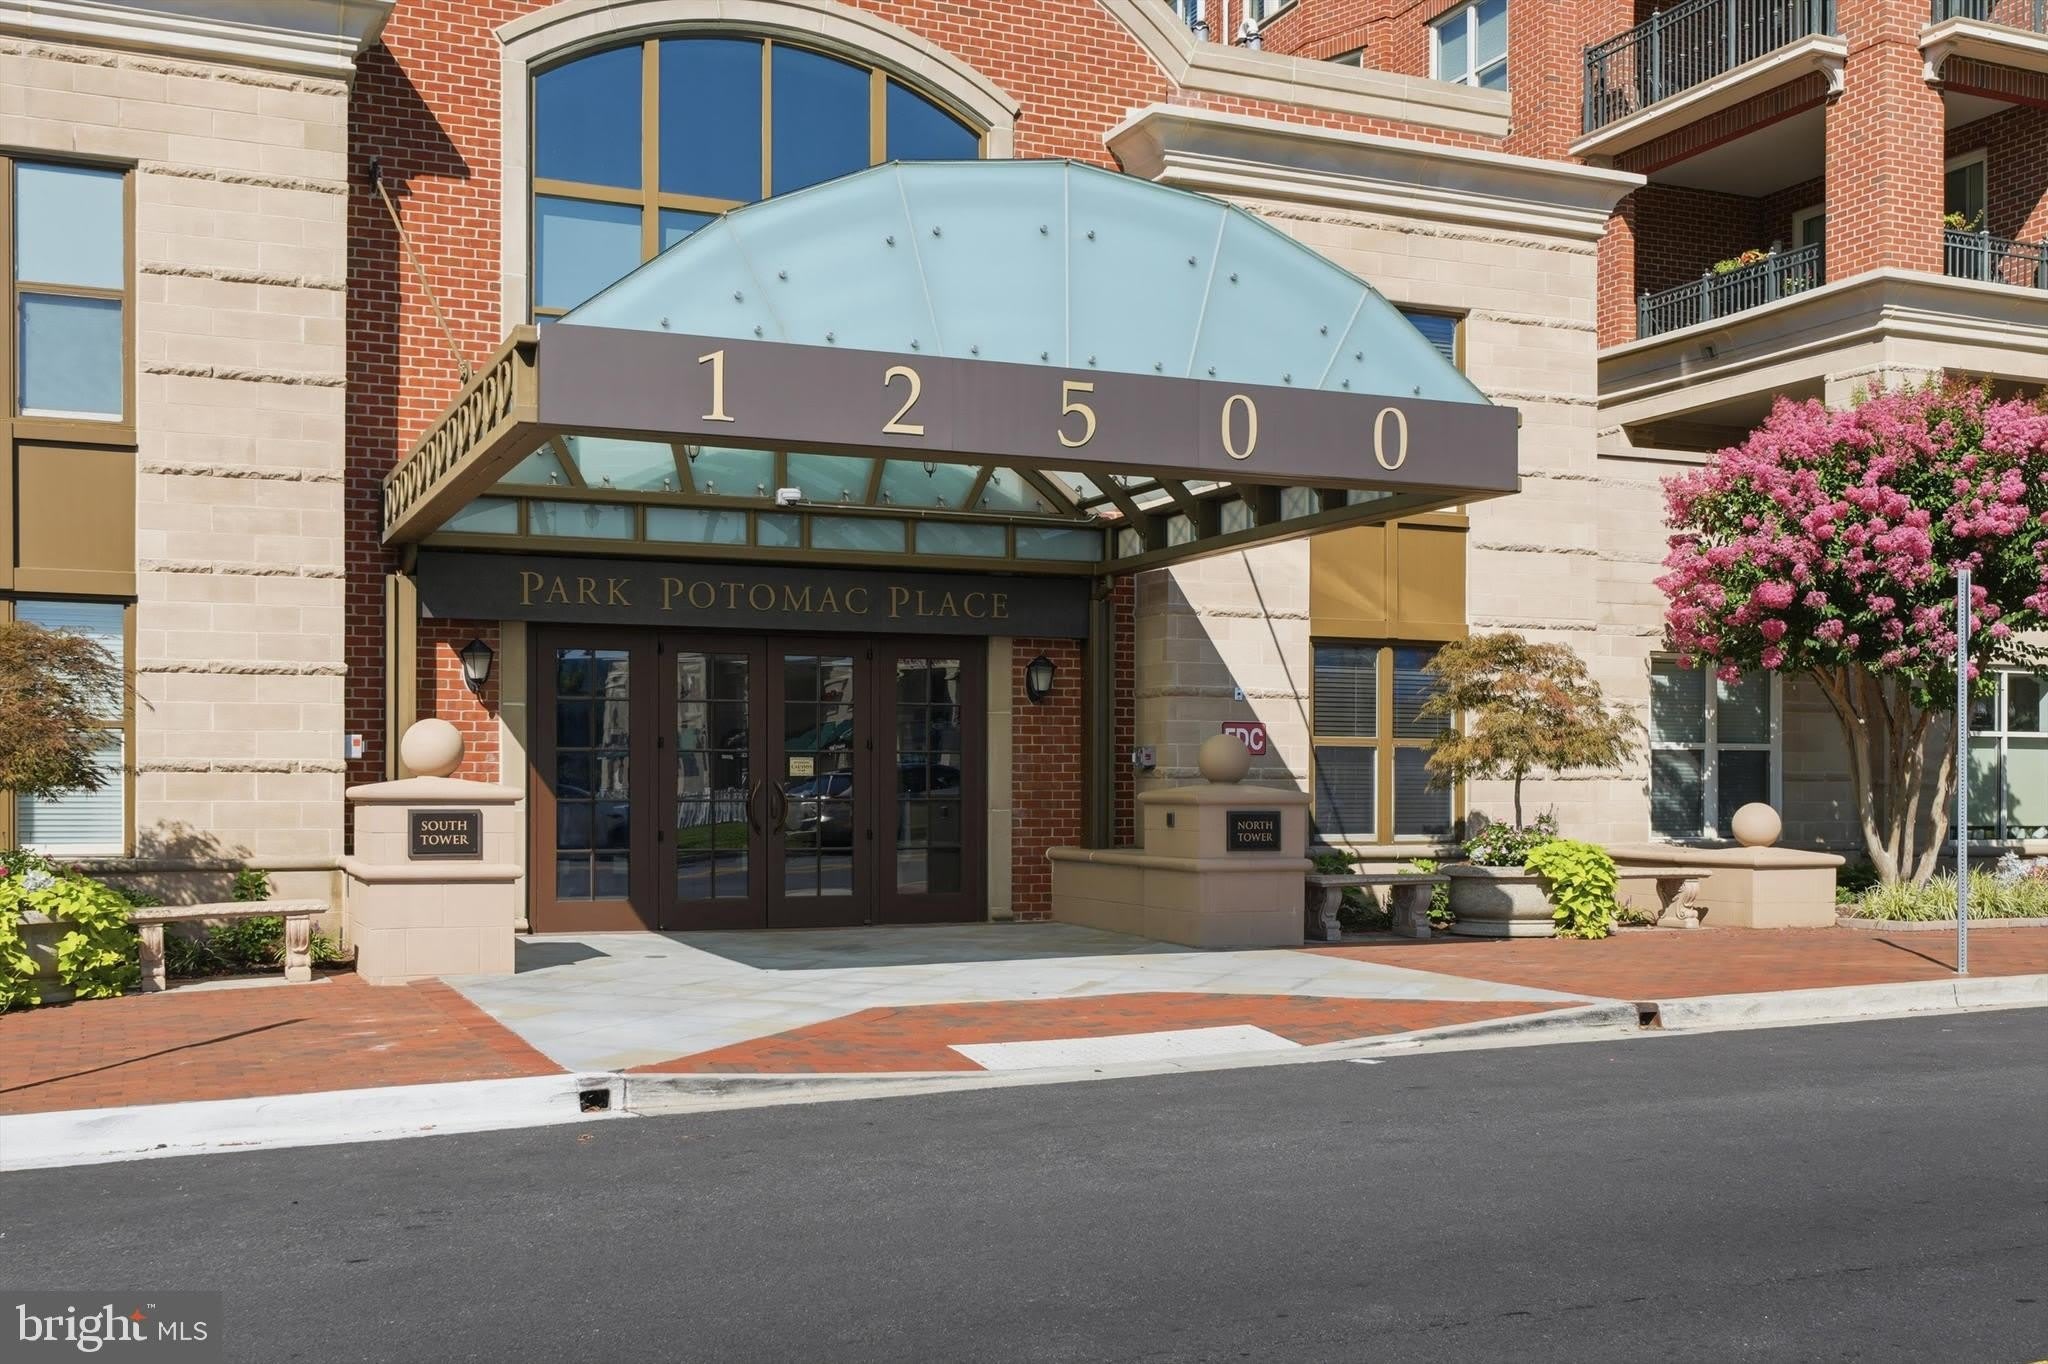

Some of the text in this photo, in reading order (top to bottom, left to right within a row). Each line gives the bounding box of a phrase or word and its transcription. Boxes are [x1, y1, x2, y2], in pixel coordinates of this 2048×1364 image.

[519, 571, 1009, 618] PARK POTOMAC PLACE
[421, 820, 467, 832] SOUTH
[1238, 821, 1273, 830] NORTH
[420, 834, 469, 845] TOWER
[1238, 833, 1273, 842] TOWER
